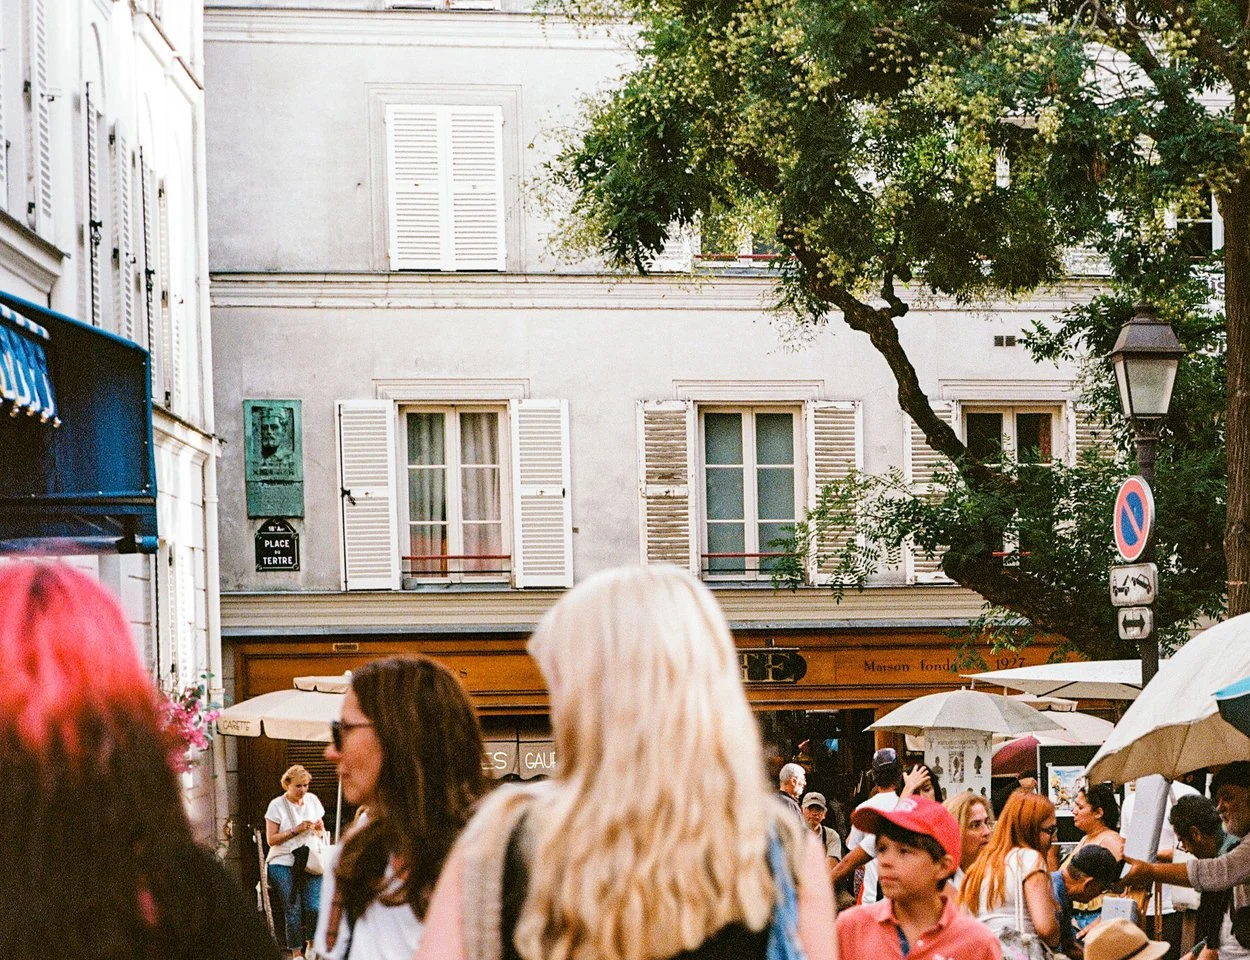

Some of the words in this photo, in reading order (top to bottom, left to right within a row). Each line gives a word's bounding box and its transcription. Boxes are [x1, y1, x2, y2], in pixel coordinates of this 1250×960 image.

[264, 539, 290, 548] PLACE
[262, 556, 293, 565] TERTRE
[863, 660, 910, 671] Maison
[995, 657, 1026, 670] 1927
